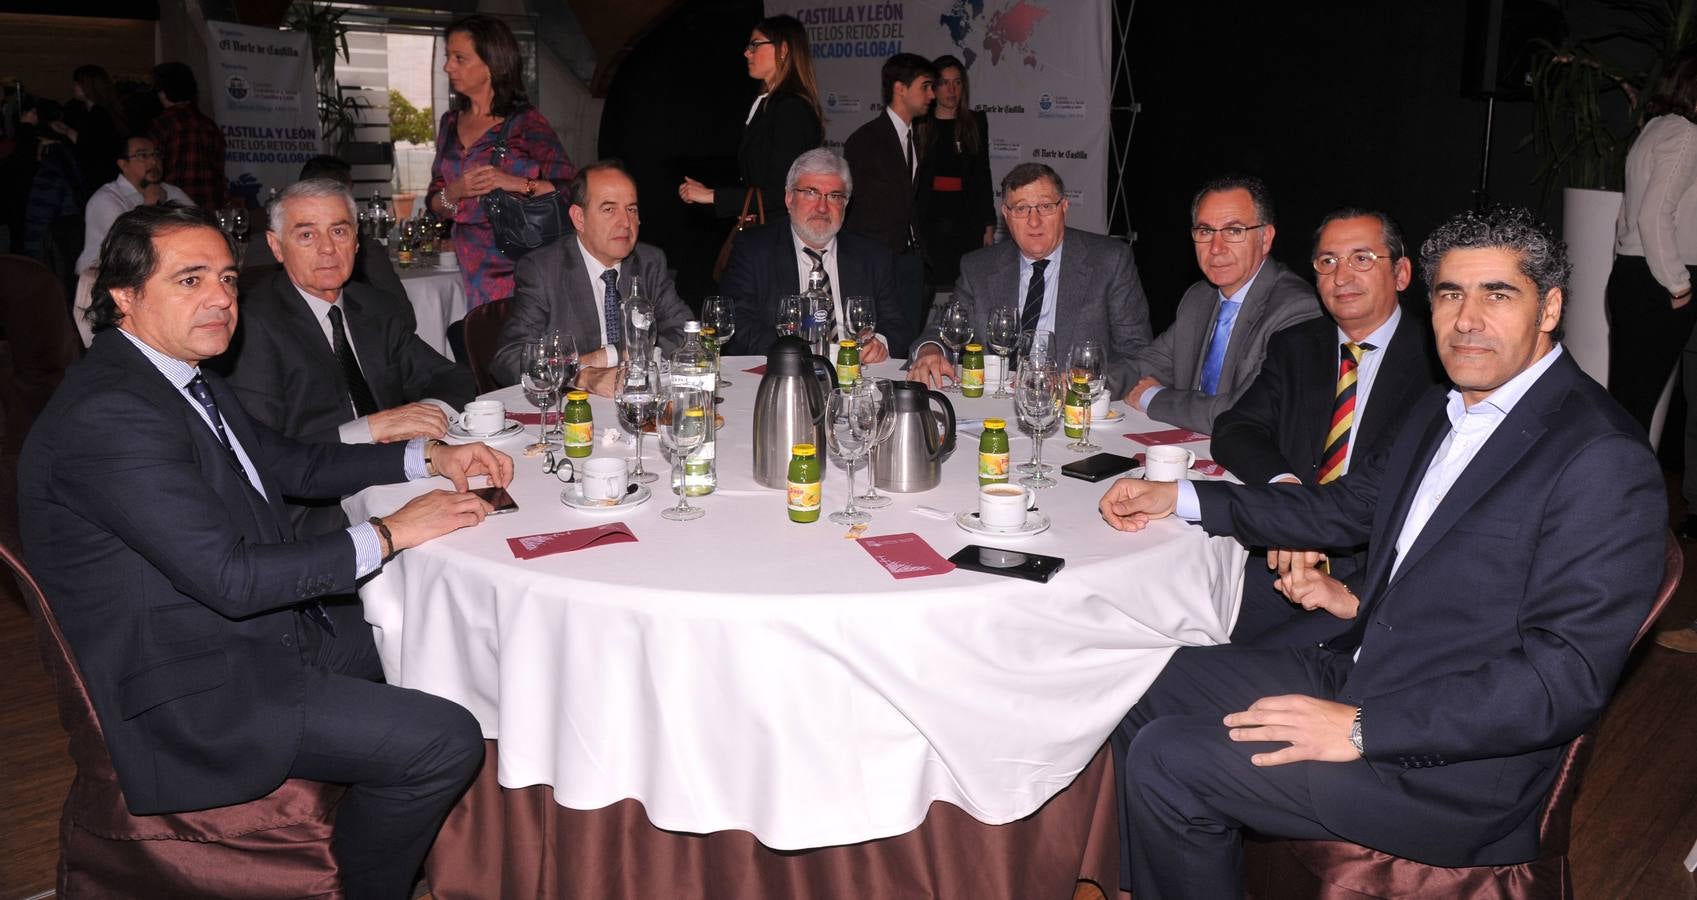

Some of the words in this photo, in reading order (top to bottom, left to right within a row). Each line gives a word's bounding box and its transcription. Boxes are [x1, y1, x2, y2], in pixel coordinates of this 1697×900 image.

[797, 7, 854, 24] CASTILLA
[857, 5, 866, 22] Y
[867, 0, 904, 21] LEÓN
[825, 26, 844, 41] LOS
[846, 24, 880, 40] RETOS
[882, 23, 904, 38] DEL
[809, 42, 853, 59] RCADO
[274, 128, 283, 139] Y
[285, 126, 316, 140] LEÓN
[248, 140, 266, 151] LOS
[267, 141, 297, 152] RETOS
[299, 142, 317, 152] DEL
[277, 153, 314, 164] GLOBA
